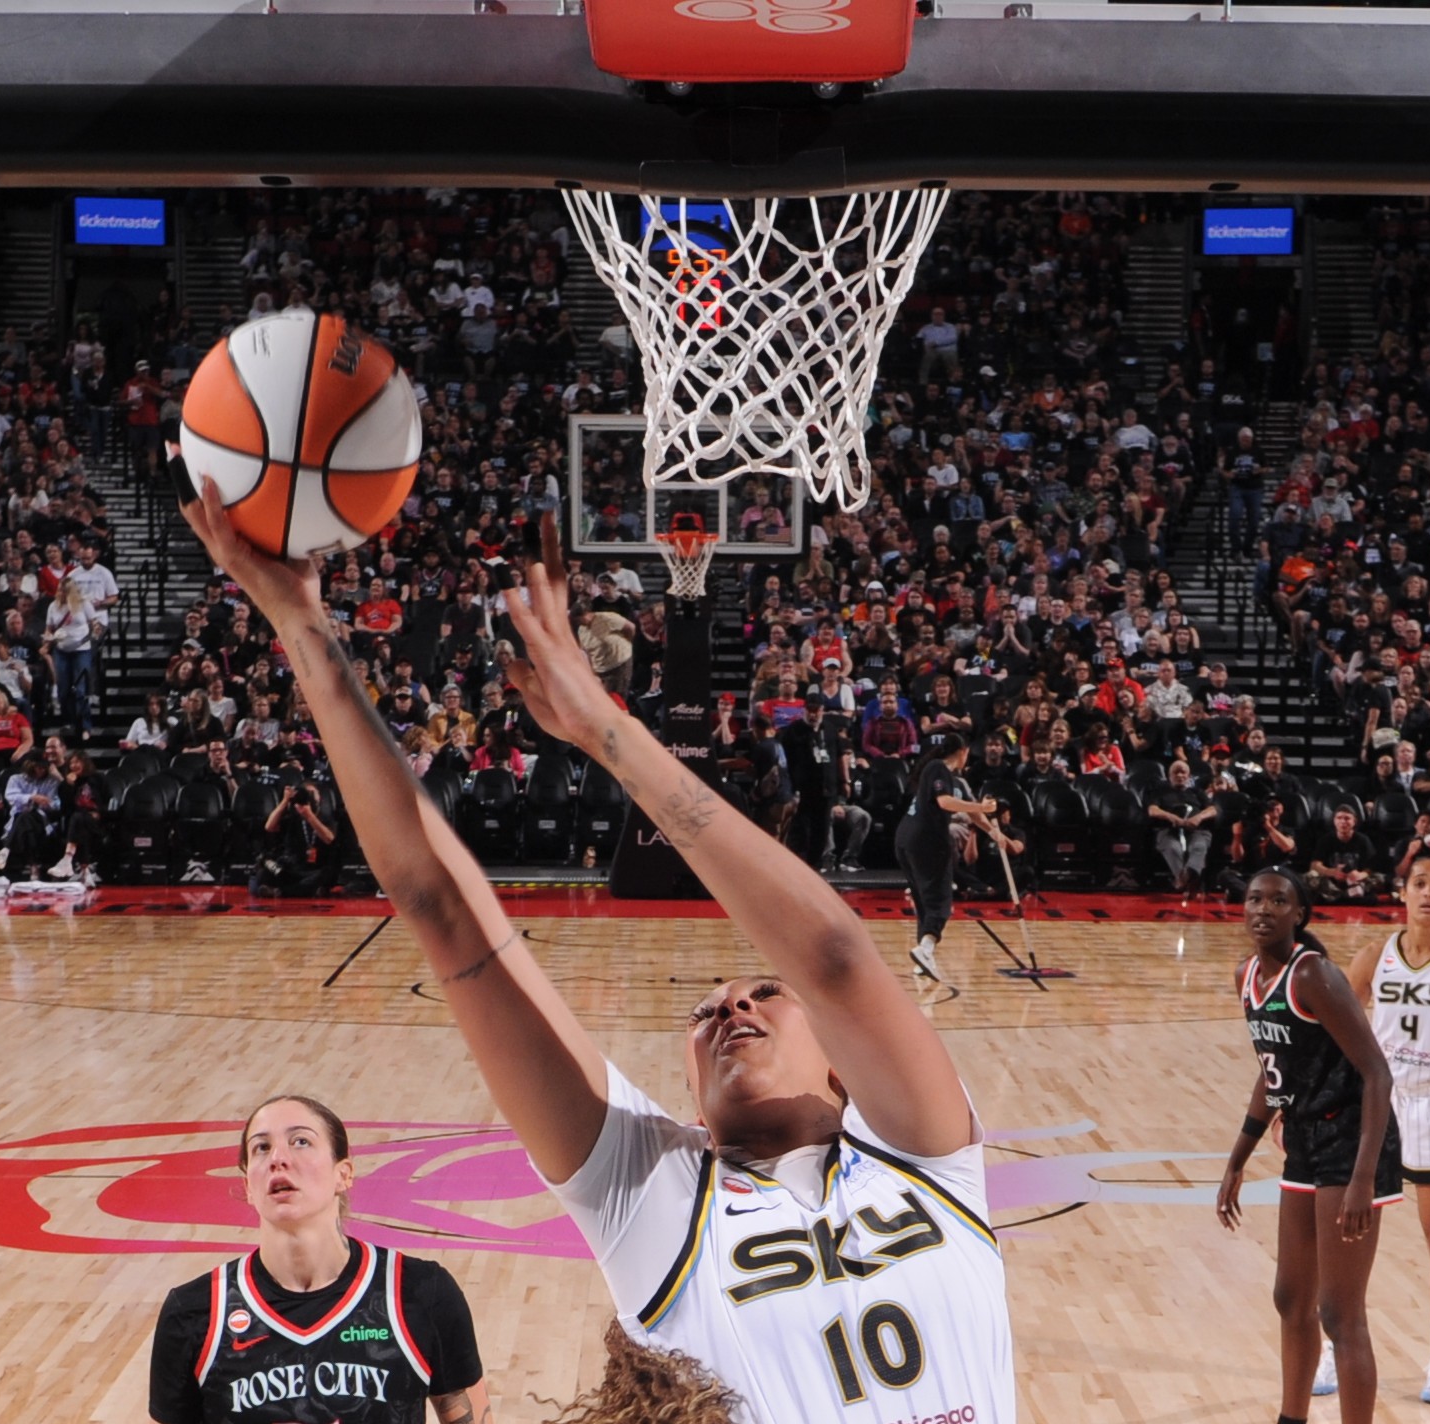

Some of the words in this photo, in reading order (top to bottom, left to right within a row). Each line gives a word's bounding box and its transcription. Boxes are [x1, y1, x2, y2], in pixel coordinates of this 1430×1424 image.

[79, 213, 160, 229] ticketmaster
[1208, 224, 1289, 239] ticketmaster
[1400, 1014, 1420, 1041] 4
[725, 1190, 947, 1306] SKY
[340, 1325, 389, 1343] chime
[823, 1299, 925, 1406] 10
[230, 1363, 307, 1413] ROSE
[314, 1361, 390, 1403] CITY
